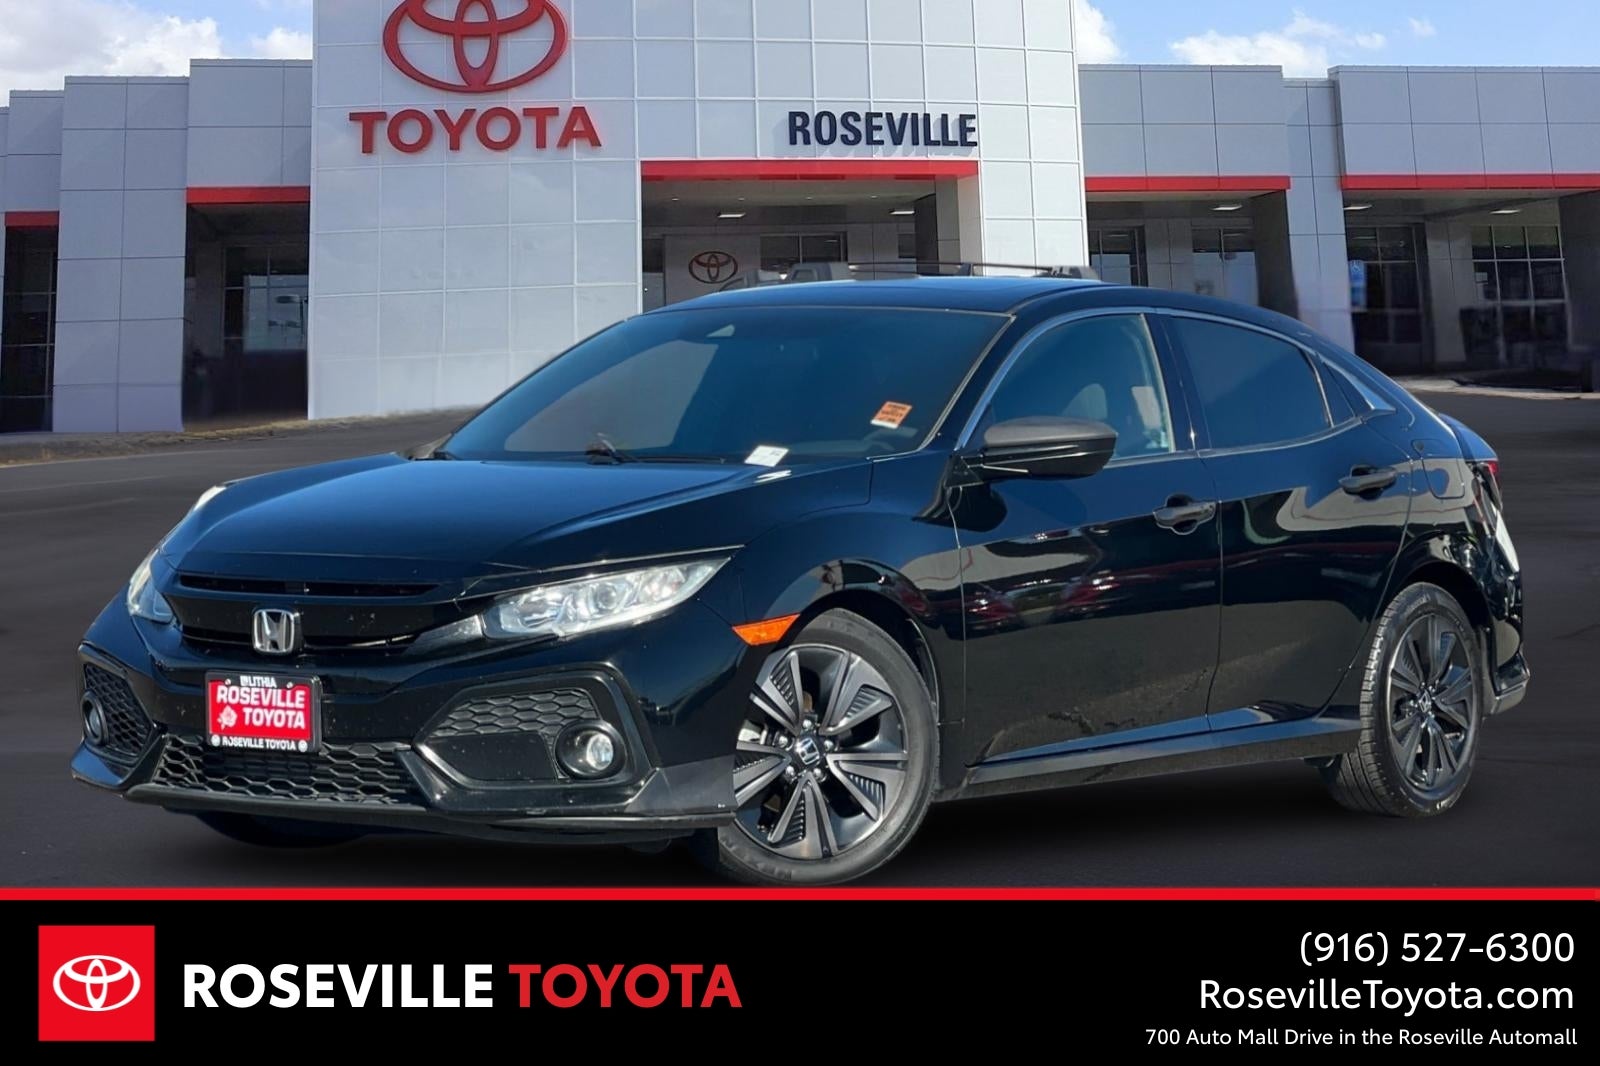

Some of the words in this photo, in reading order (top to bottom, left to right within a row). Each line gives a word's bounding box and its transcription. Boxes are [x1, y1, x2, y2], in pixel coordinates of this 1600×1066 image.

[349, 105, 602, 154] TOYOTA
[788, 110, 978, 148] ROSEVILLE
[248, 676, 277, 688] LITHIA
[216, 686, 305, 709] ROSEVILLE
[242, 707, 306, 730] TOYOTA
[222, 736, 264, 749] ROSEVILLE
[265, 739, 297, 751] TOYOTA
